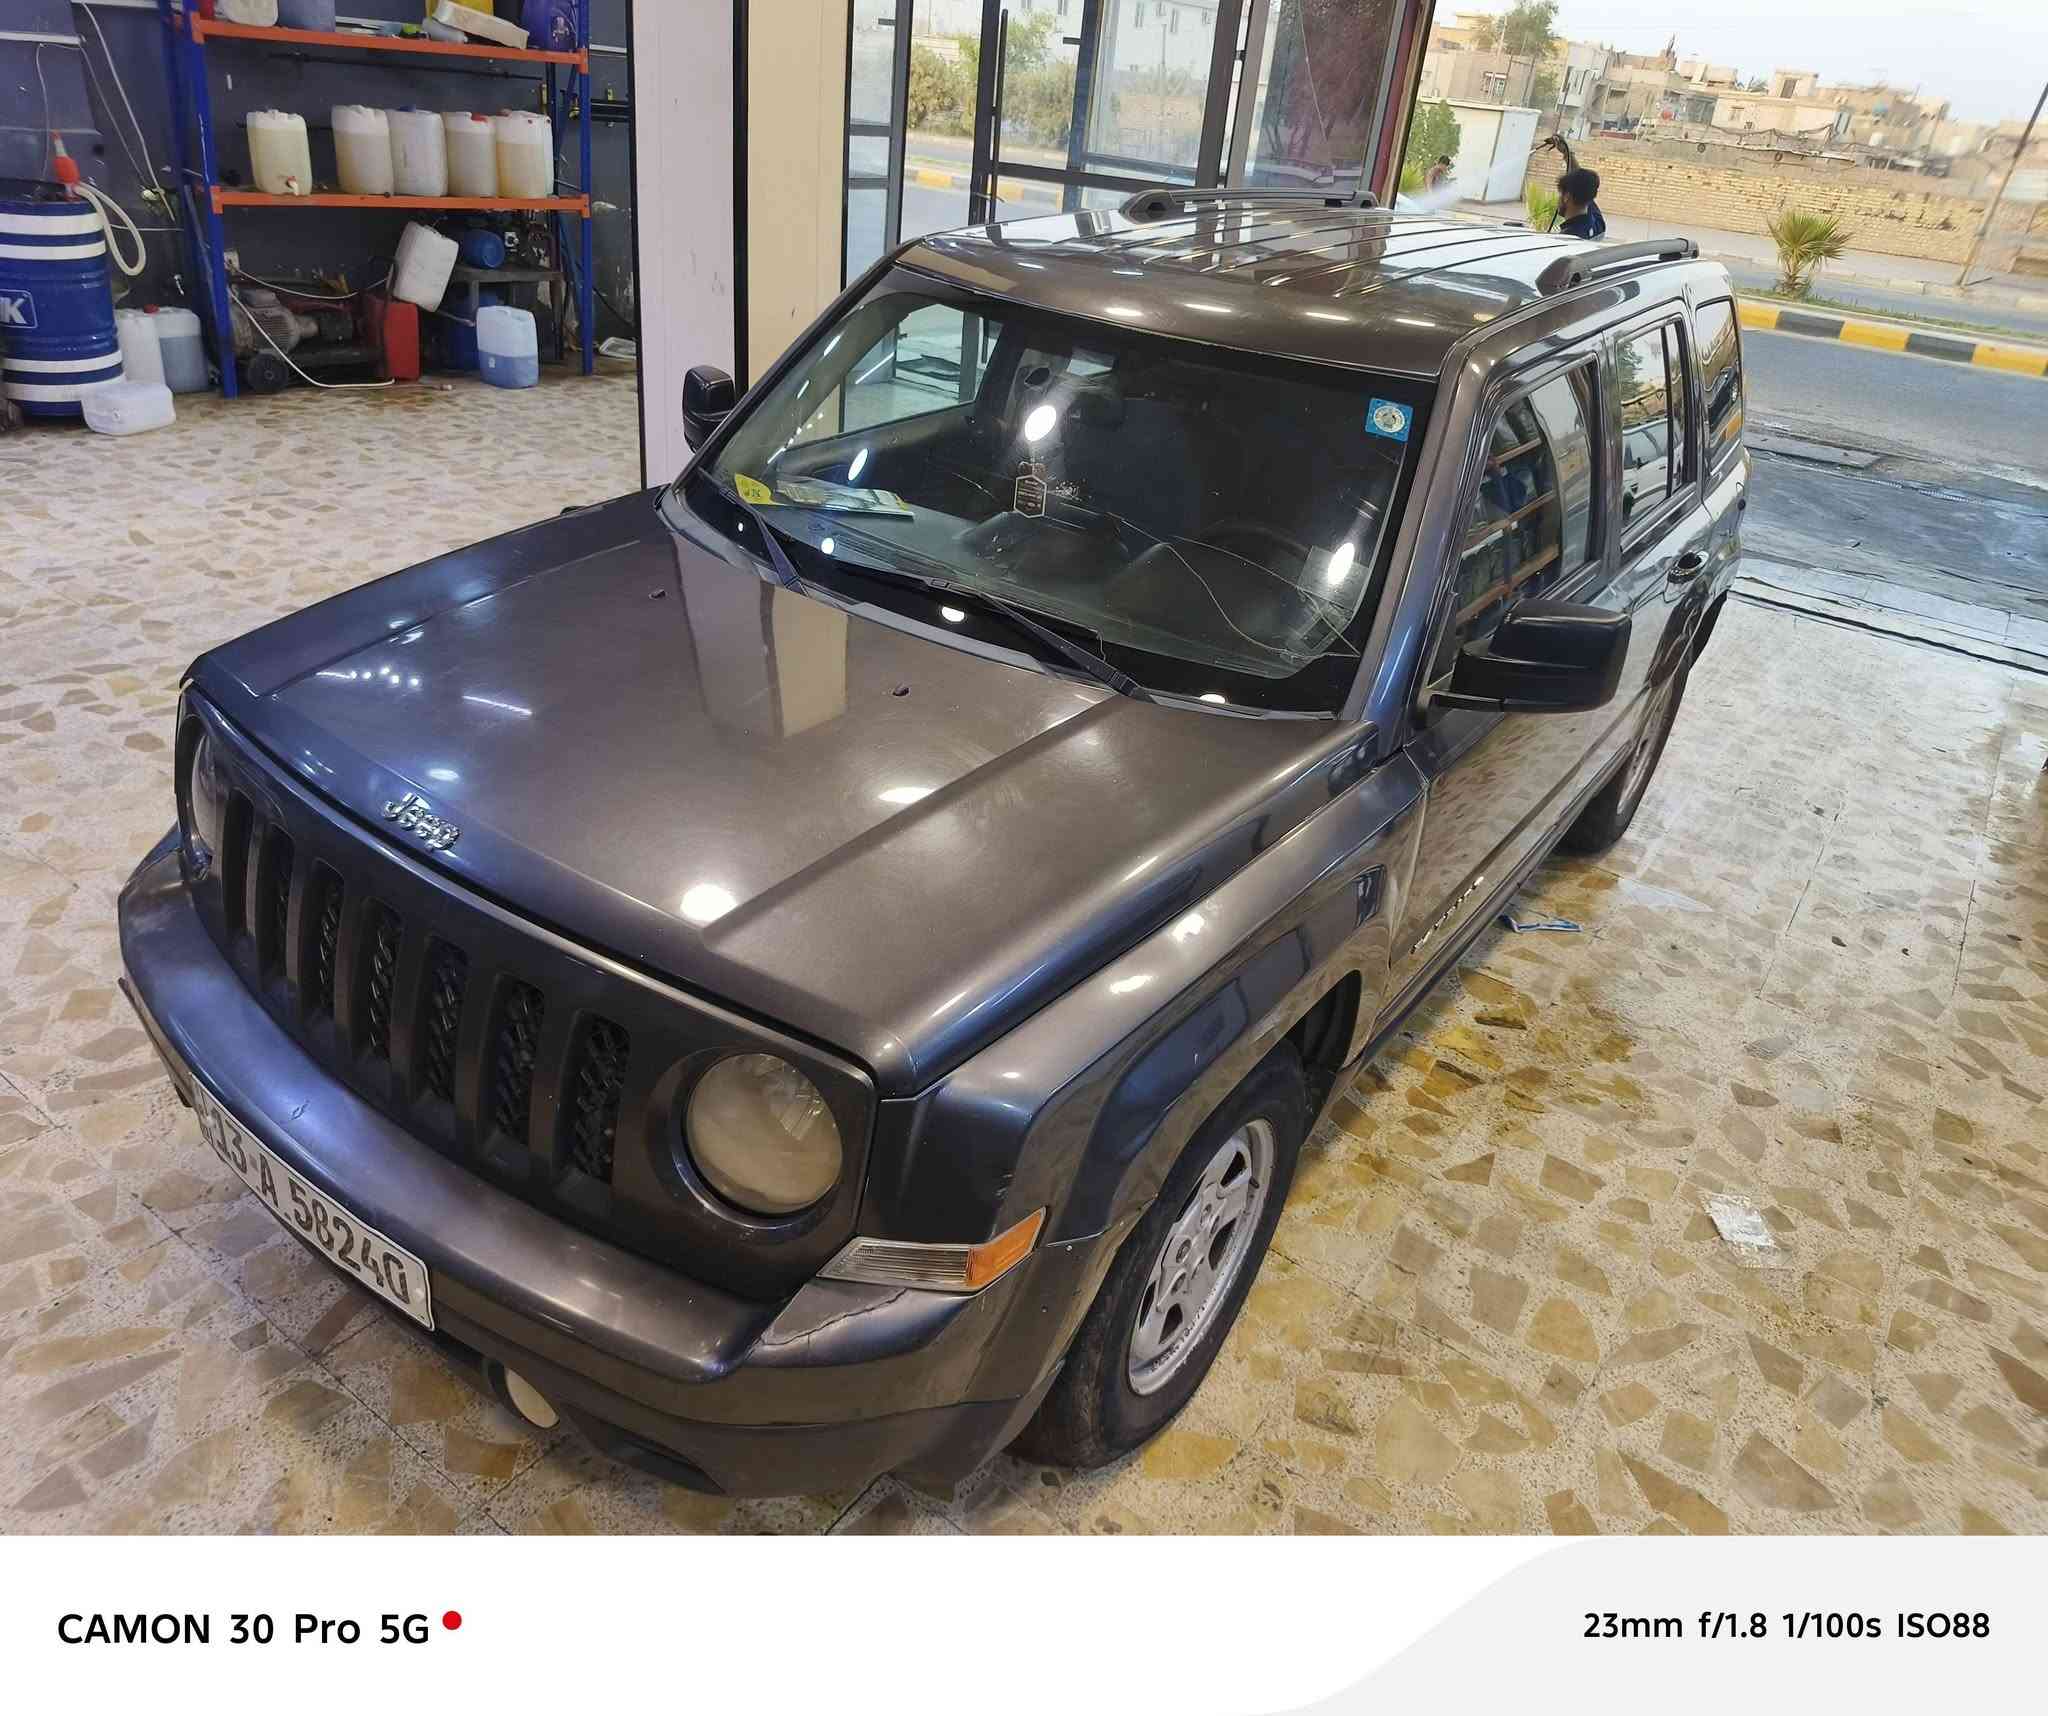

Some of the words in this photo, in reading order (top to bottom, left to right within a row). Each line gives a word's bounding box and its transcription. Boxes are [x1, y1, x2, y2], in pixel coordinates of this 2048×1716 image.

[383, 792, 460, 852] Jeep
[259, 1151, 279, 1208] A
[288, 1176, 410, 1305] 58240
